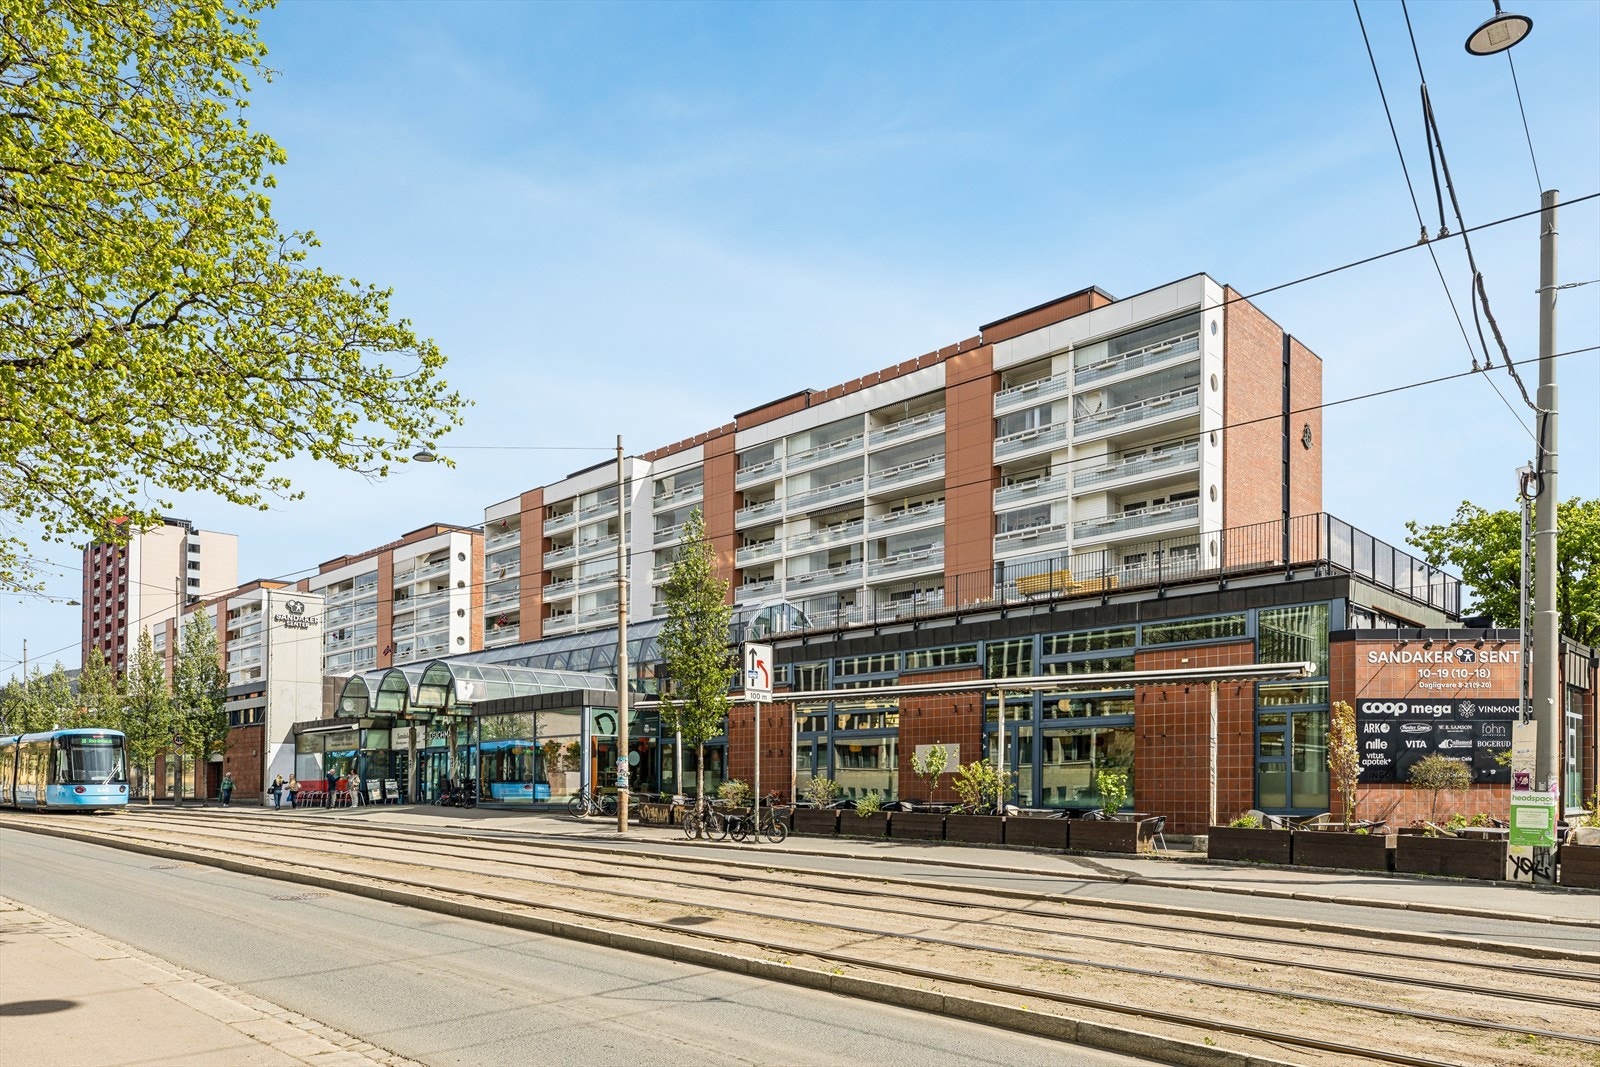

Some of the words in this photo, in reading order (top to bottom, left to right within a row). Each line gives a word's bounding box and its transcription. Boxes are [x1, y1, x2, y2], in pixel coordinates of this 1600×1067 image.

[275, 613, 319, 624] SANDAKER
[286, 621, 310, 629] SENTER
[1368, 650, 1453, 663] SANDAKER
[1479, 650, 1534, 663] SENT
[1418, 668, 1449, 678] 10-19
[1451, 668, 1491, 679] (10-18)
[1419, 681, 1457, 690] Dagligvare
[750, 692, 761, 700] 100
[1362, 702, 1408, 717] coop
[1411, 704, 1452, 717] mega
[1365, 738, 1388, 749] nille
[1405, 740, 1427, 748] VITA
[1477, 740, 1511, 748] BOGERUD
